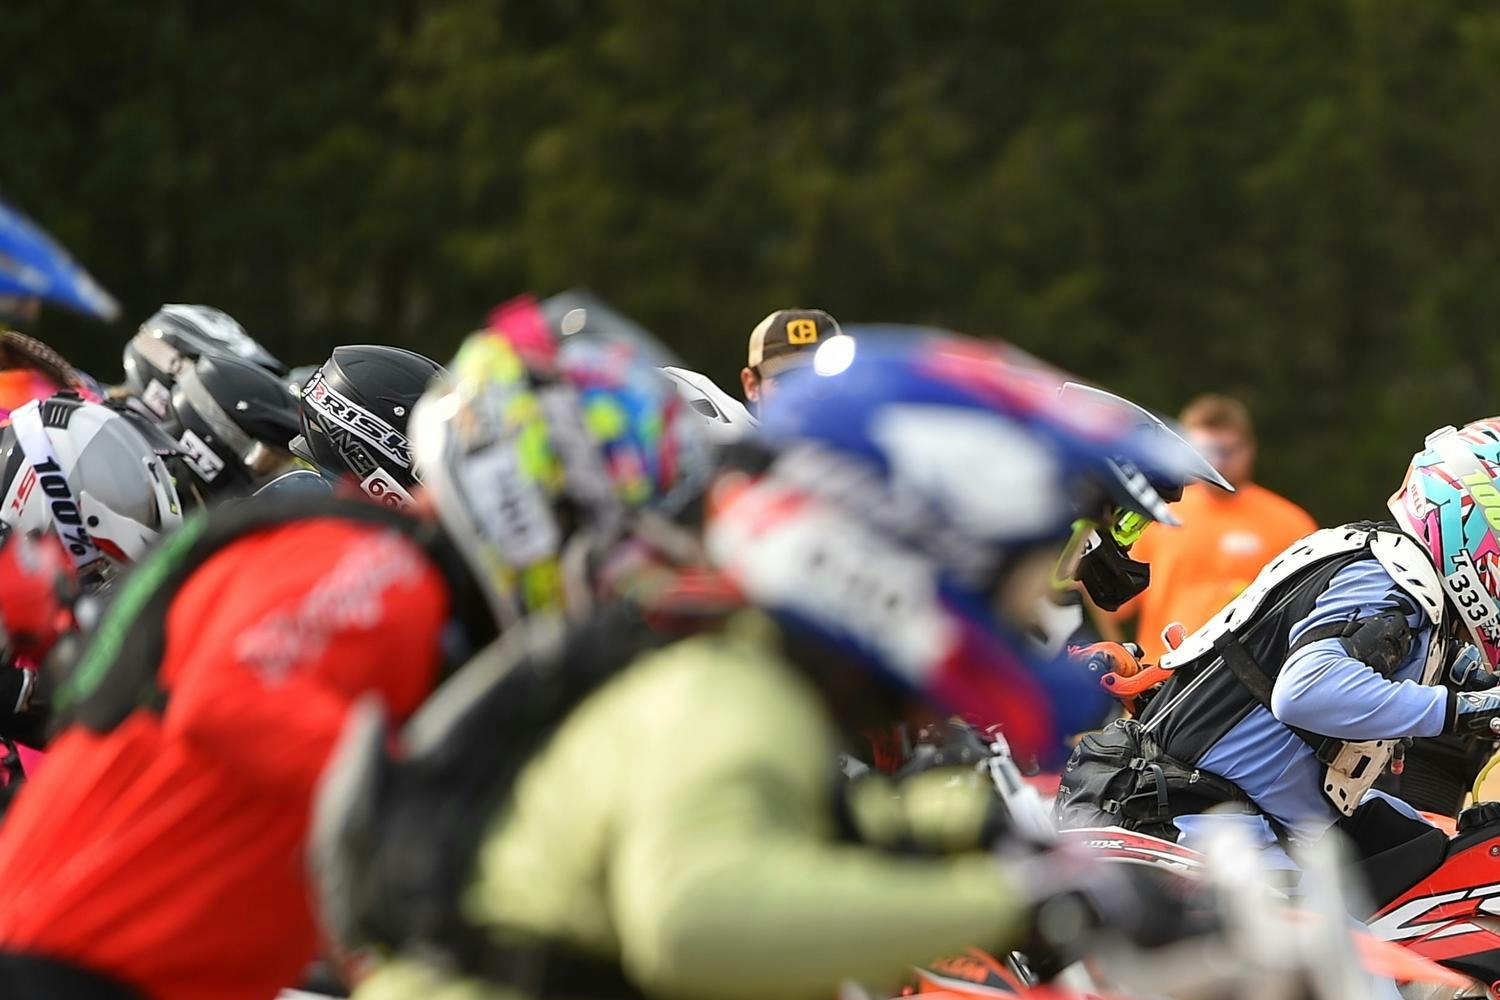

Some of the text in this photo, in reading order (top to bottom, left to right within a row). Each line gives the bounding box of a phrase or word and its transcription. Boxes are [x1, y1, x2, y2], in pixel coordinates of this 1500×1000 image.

[320, 395, 413, 461] RISK
[33, 455, 98, 556] 100%
[1449, 574, 1489, 621] 333
